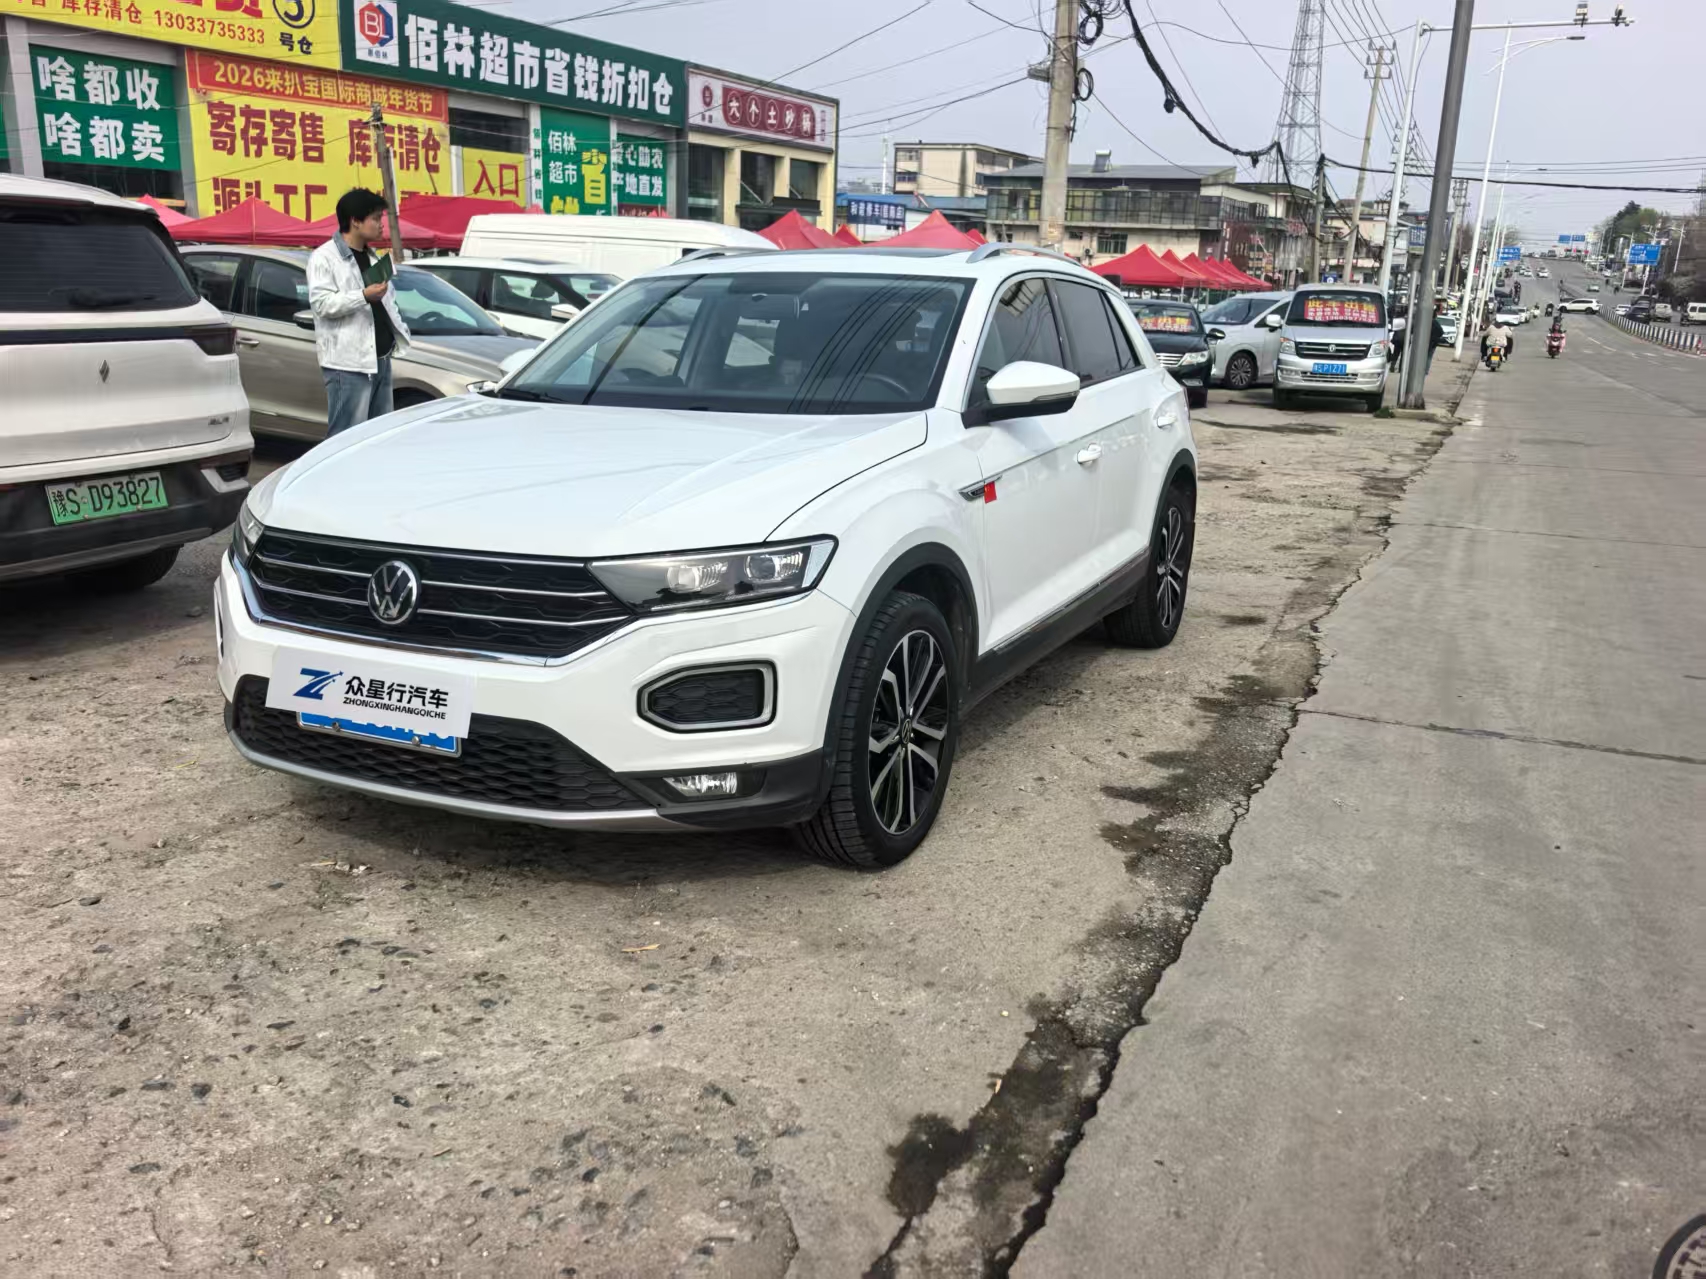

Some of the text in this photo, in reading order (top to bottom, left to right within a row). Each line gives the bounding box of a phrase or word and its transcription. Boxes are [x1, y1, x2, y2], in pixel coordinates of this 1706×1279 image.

[154, 10, 265, 44] 13033735333
[279, 32, 313, 55] 号仓
[404, 14, 673, 115] 佰林超市省钱折扣仓
[37, 56, 161, 110] 啥都收
[43, 112, 165, 163] 啥都卖
[207, 101, 326, 163] 寄存寄售
[547, 129, 577, 156] 佰林
[473, 159, 519, 198] 入口
[548, 160, 578, 185] 超市
[581, 148, 608, 205] 省
[342, 696, 447, 720] ZHONGXINGHANGQICHE
[344, 675, 449, 709] 众星行汽车
